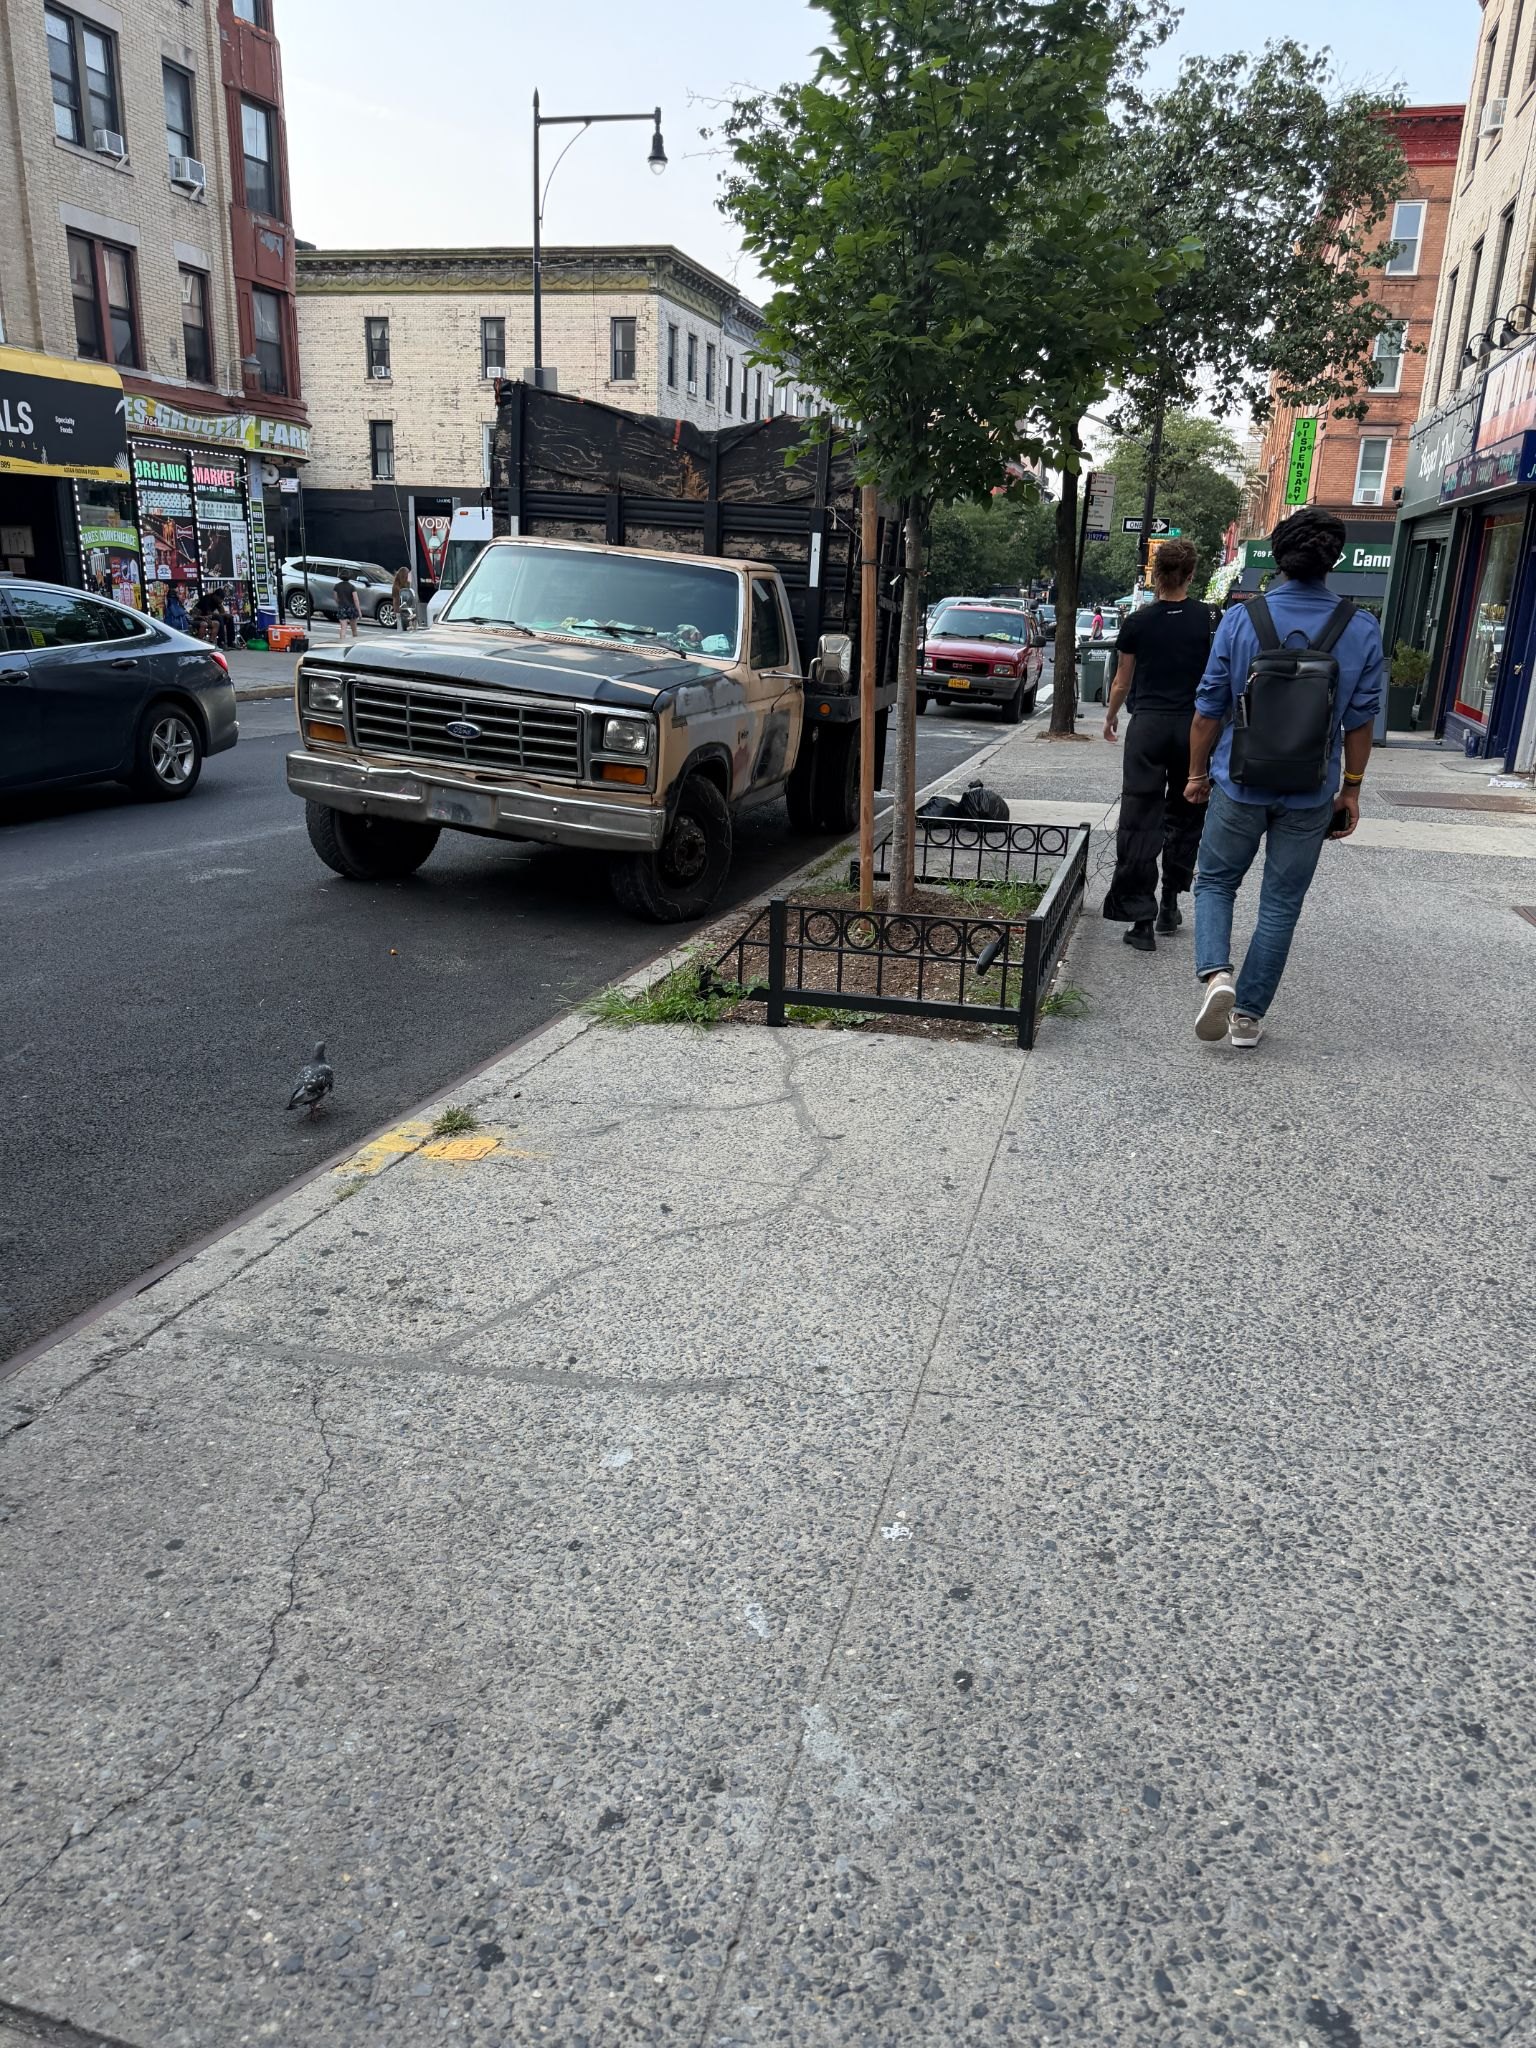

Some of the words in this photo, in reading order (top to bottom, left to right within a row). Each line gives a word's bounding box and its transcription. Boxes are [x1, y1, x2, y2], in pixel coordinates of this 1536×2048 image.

[55, 416, 75, 426] Specialty
[144, 416, 157, 426] 764
[155, 403, 252, 440] GROCERY
[60, 426, 73, 434] Foods
[1293, 421, 1310, 501] DISPENSARY
[134, 459, 188, 483] ORGANIC
[193, 466, 235, 487] MARKET
[1129, 521, 1143, 529] ONE
[100, 530, 136, 547] CONVENIENCE
[1253, 550, 1266, 558] 769
[1353, 549, 1391, 568] Cann
[952, 662, 973, 670] GMC
